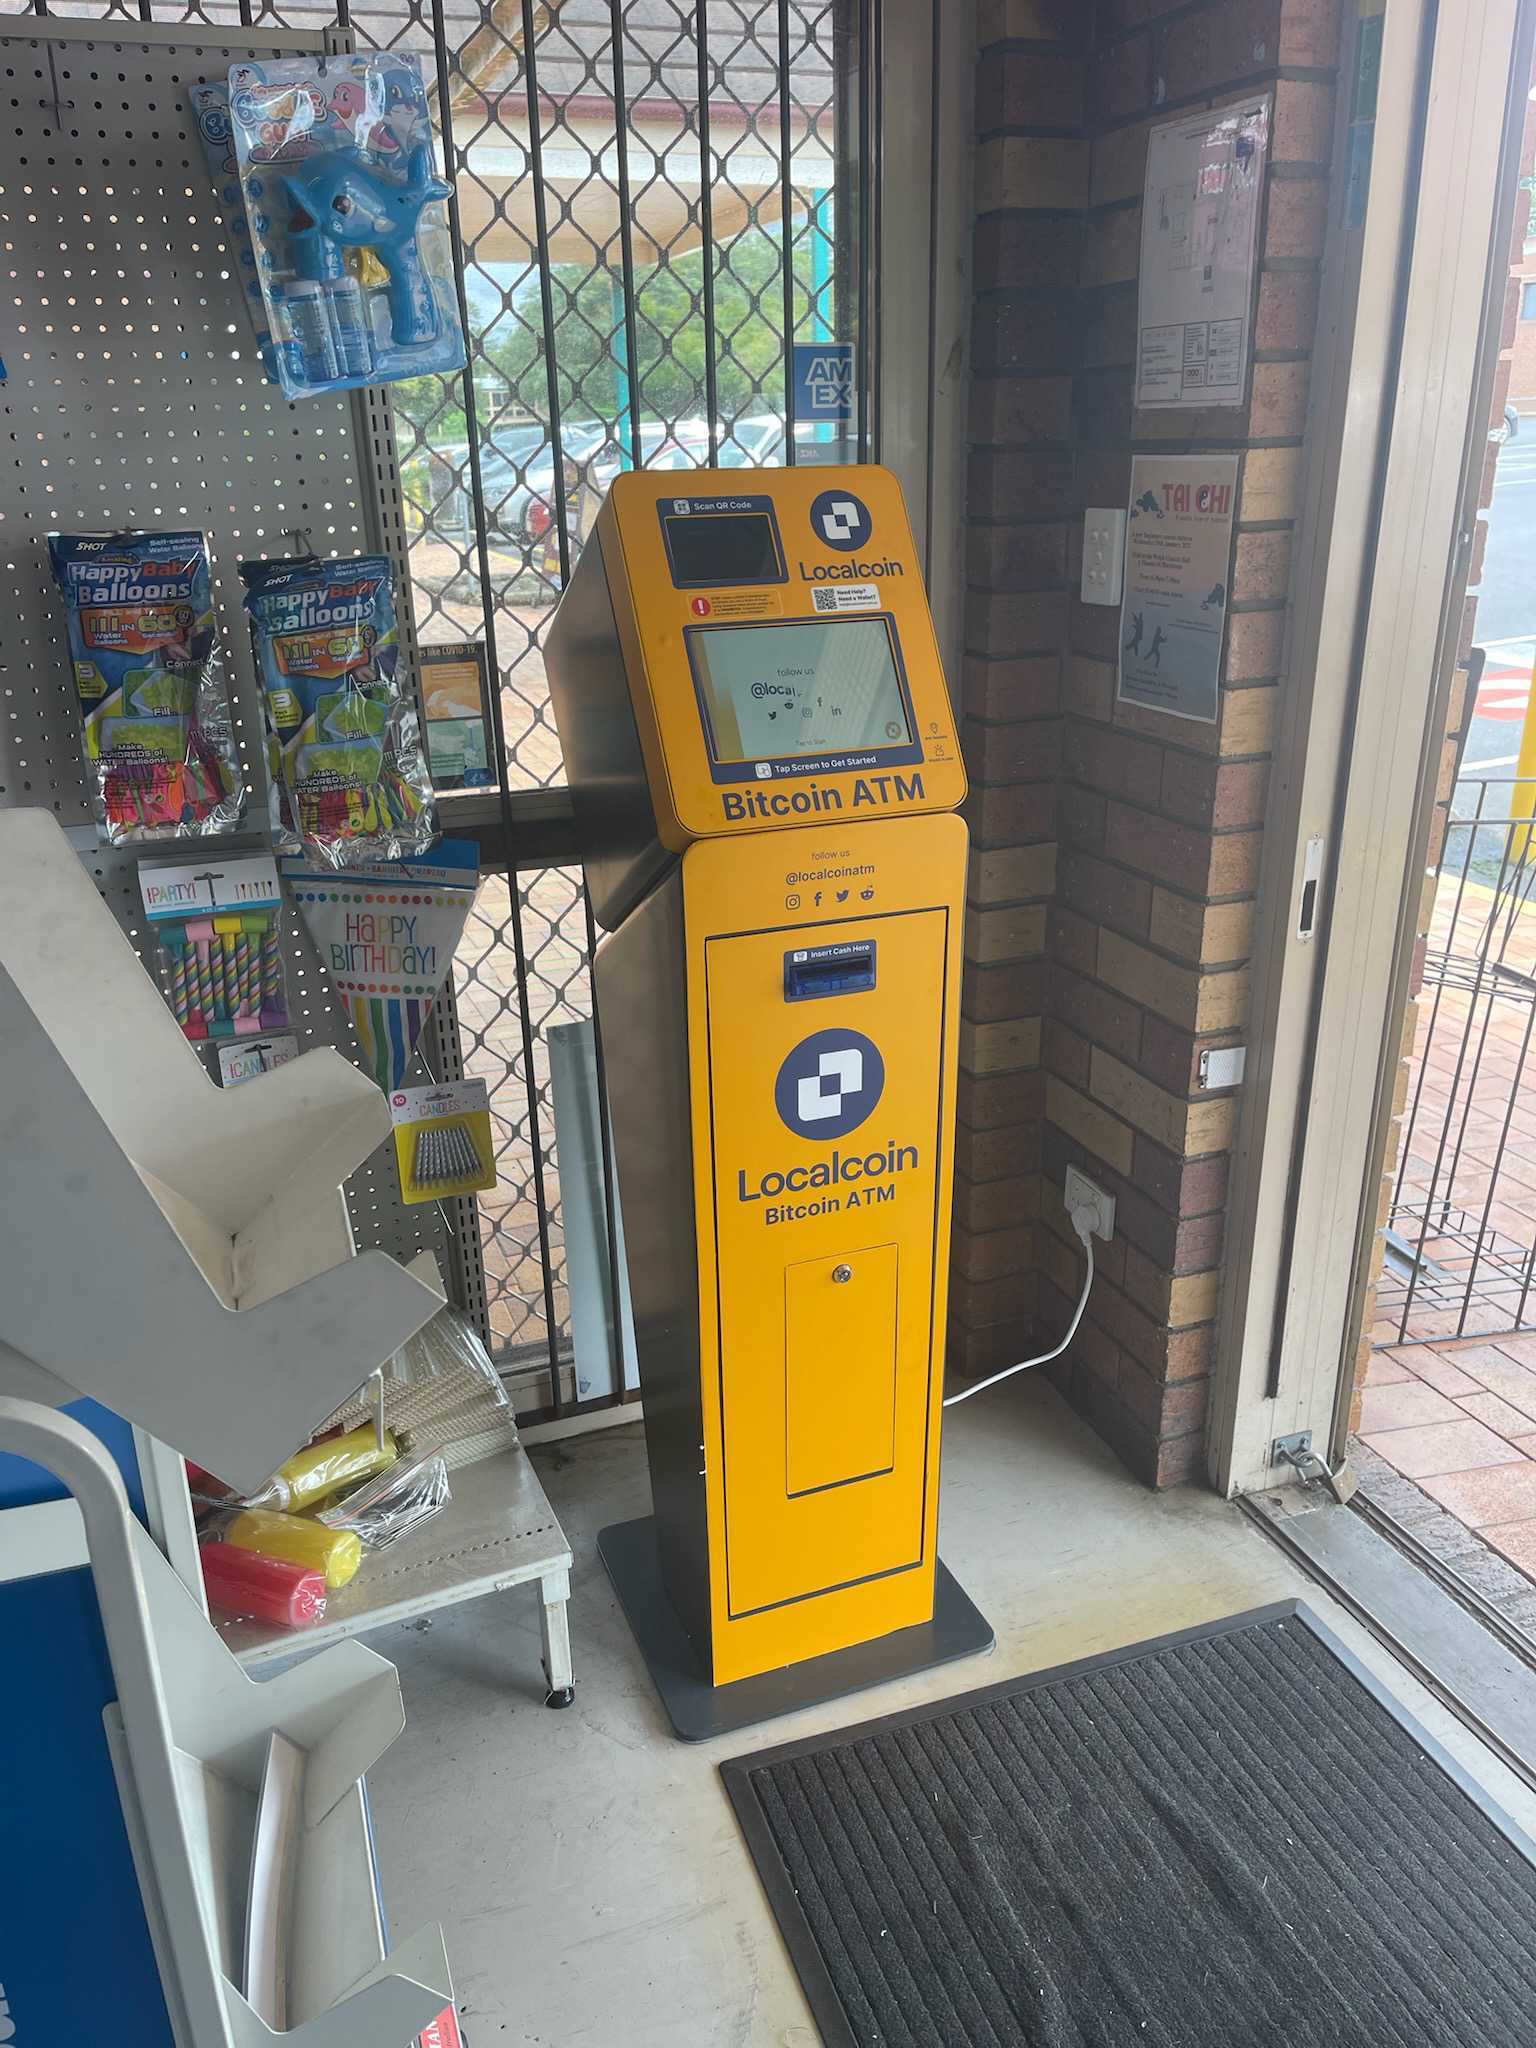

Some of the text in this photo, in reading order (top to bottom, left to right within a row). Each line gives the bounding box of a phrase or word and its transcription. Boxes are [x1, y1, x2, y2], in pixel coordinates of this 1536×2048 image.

[694, 501, 752, 510] Scan QR Code
[1162, 483, 1231, 514] TAI CHI
[76, 542, 108, 550] SHOT
[72, 566, 142, 583] Happy
[799, 556, 904, 581] Localcoin
[264, 574, 293, 587] SHOT
[78, 583, 191, 603] Balloons
[122, 624, 135, 632] IN
[138, 614, 176, 632] 60
[268, 602, 372, 631] Balloons
[79, 663, 96, 678] 3
[777, 668, 803, 677] follow
[272, 692, 291, 708] 3
[204, 728, 228, 737] PCS
[394, 746, 417, 757] PCS
[774, 765, 790, 774] Tap
[792, 763, 820, 772] Screen
[831, 759, 846, 768] Get
[847, 756, 877, 766] Started
[296, 786, 319, 794] ATER
[722, 773, 926, 821] Bitcoin ATM
[811, 851, 838, 860] follow
[785, 864, 875, 885] @localcoinatm
[810, 944, 870, 958] Insert Cash Here
[394, 1096, 406, 1105] 10
[738, 1140, 918, 1202] Localcoin
[765, 1184, 895, 1226] Bitcoin ATM
